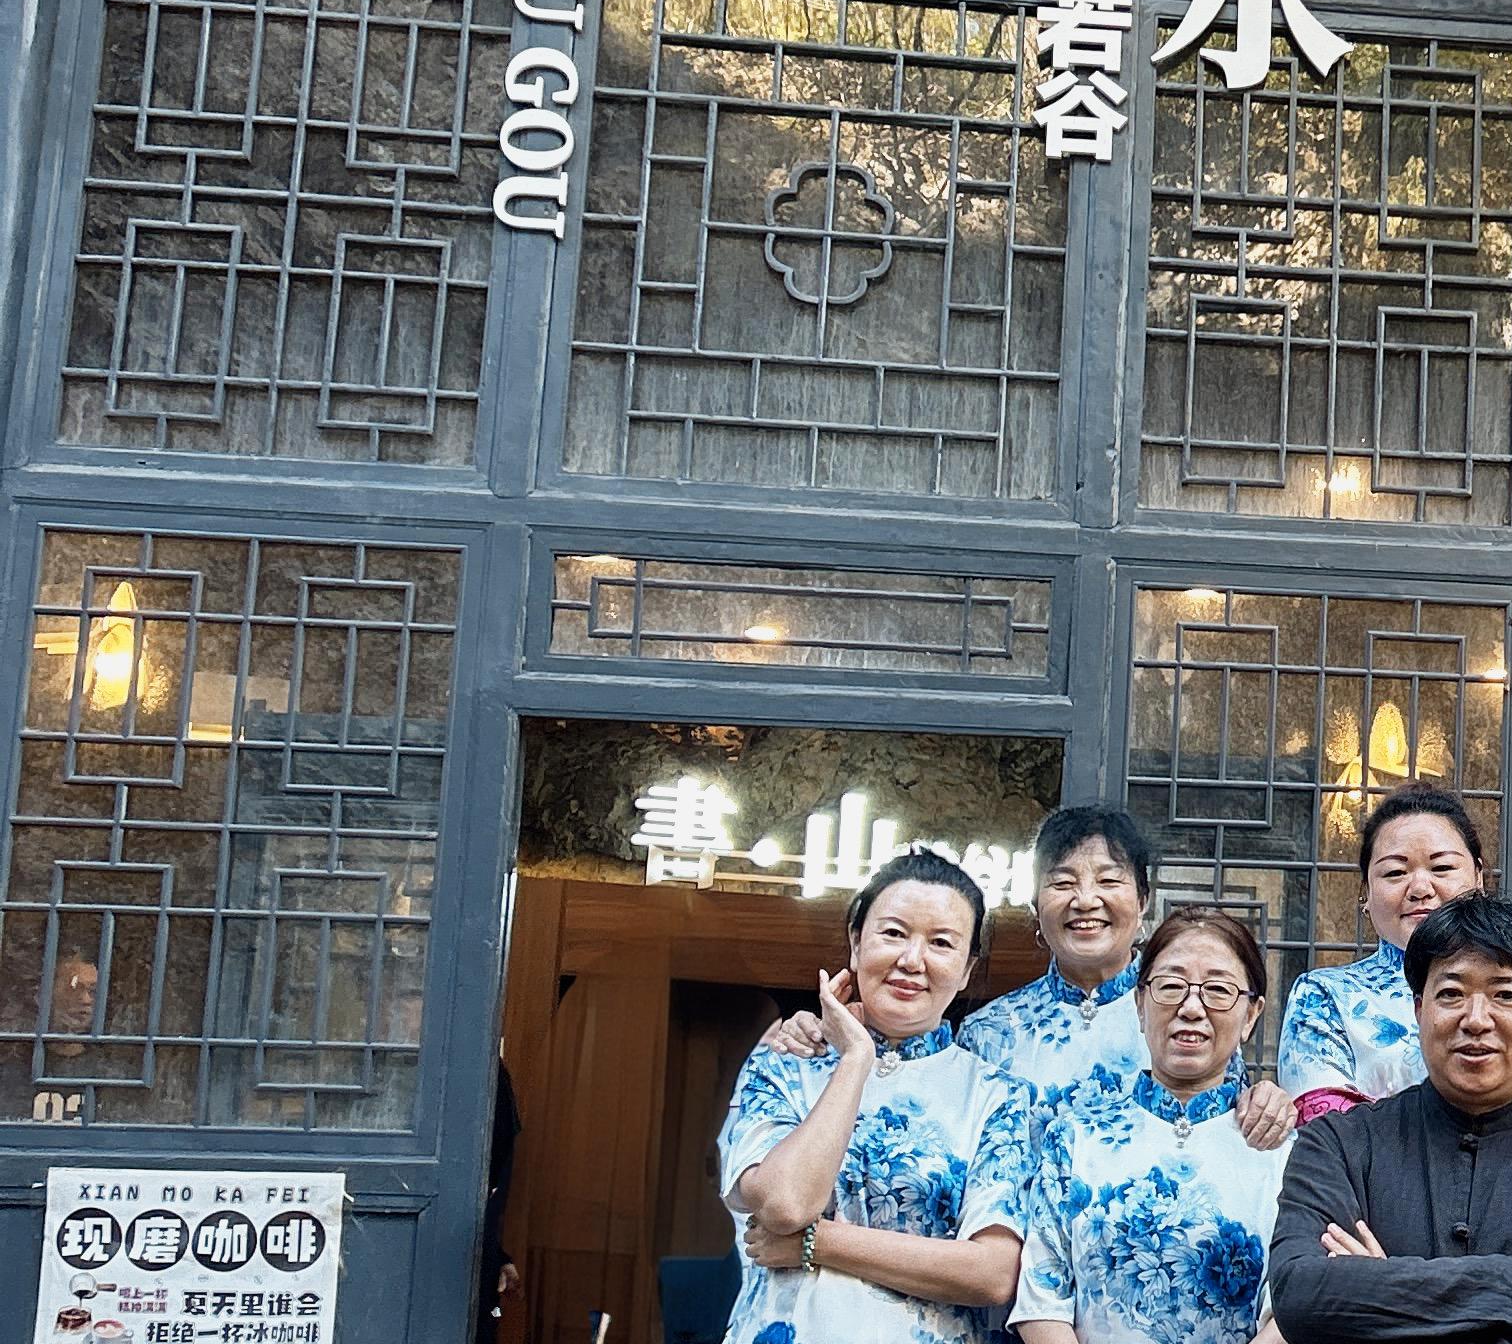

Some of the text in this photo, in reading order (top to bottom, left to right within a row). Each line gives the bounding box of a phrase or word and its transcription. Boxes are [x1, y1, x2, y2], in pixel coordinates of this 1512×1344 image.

[492, 50, 580, 239] GOU
[79, 1184, 311, 1203] XIAN MO KA FEI
[60, 1214, 319, 1264] 现磨咖啡
[183, 1291, 322, 1315] 夏天里谁会
[147, 1322, 319, 1343] 拒绝一杯冰咖啡
